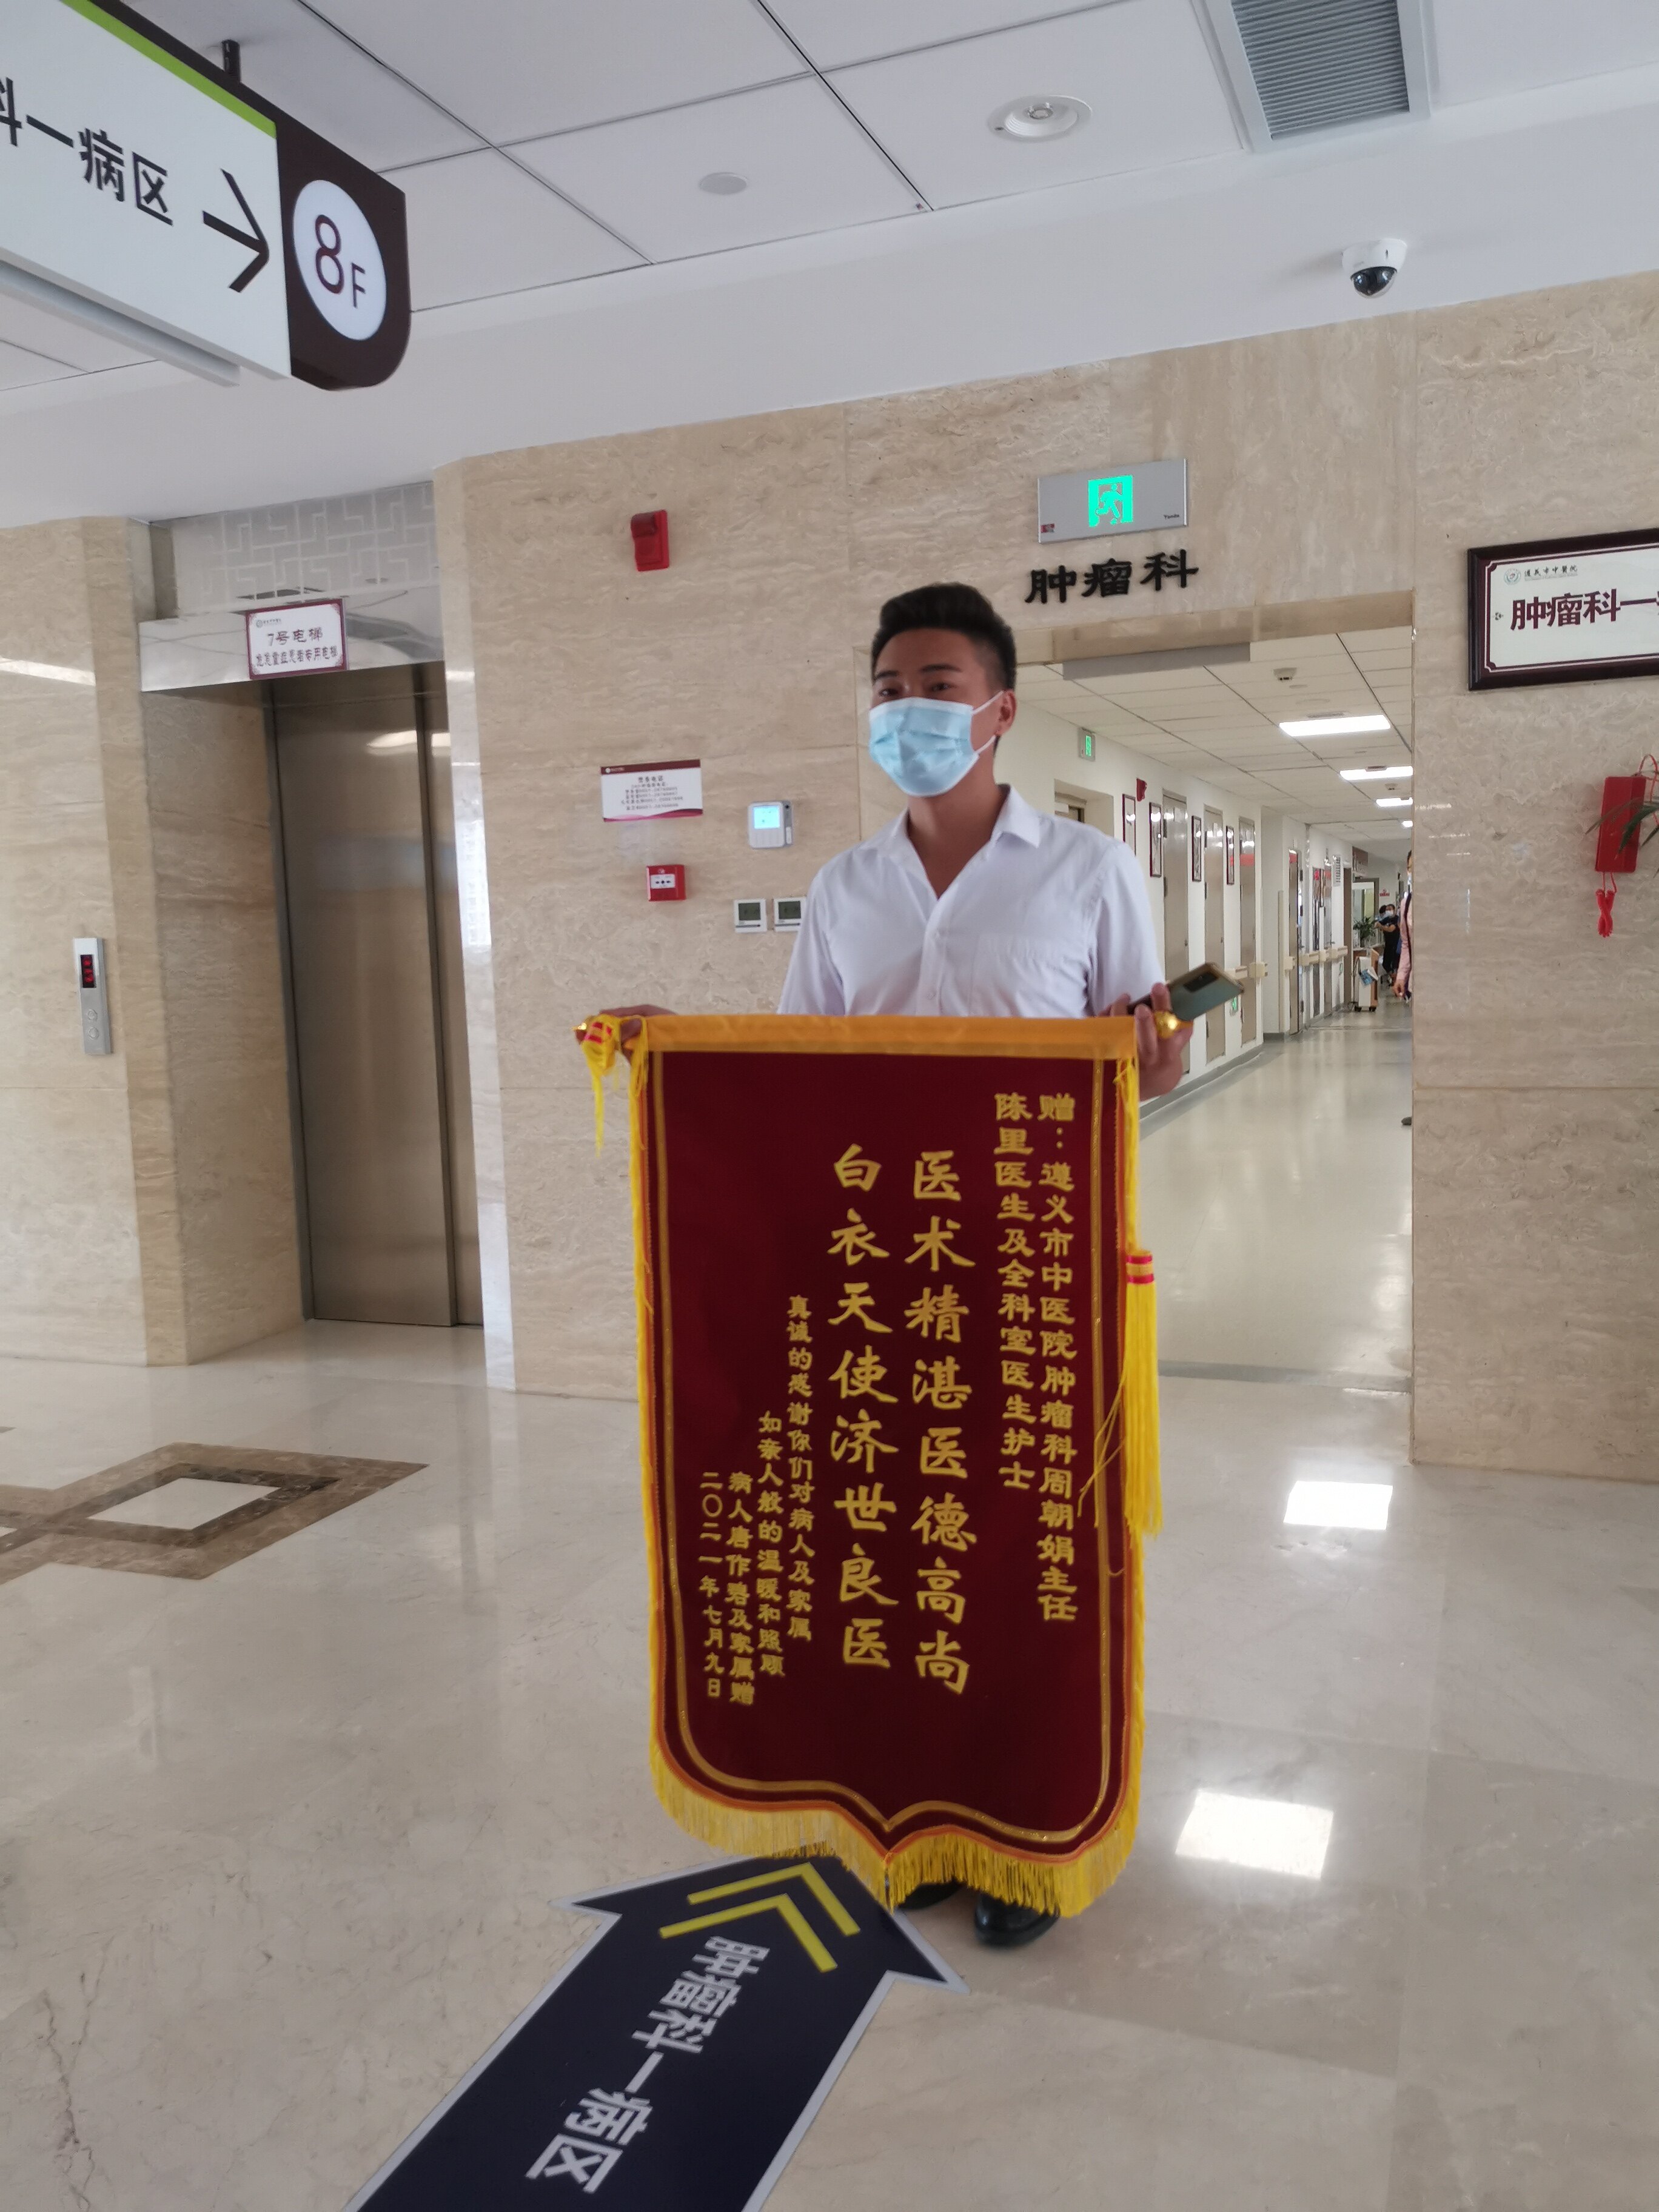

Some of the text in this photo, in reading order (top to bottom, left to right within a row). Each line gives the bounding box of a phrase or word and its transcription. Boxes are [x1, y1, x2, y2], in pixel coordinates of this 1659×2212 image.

[315, 214, 366, 309] 8F
[267, 627, 323, 646] 7号电梯
[1025, 549, 1199, 604] 肿瘤科
[1510, 588, 1659, 631] 肿瘤科一
[827, 1143, 899, 1669] 白衣天使济世良医
[993, 1092, 1036, 1490] 陈里医生及全科室医生护士
[756, 1410, 785, 1677] 如亲人般的温暖和照顾
[786, 1295, 815, 1641] 真诚的感谢你们对病人及家属
[904, 1150, 977, 1695] 医术精湛医德高尚
[525, 1936, 770, 2194] 肿瘤科一病区
